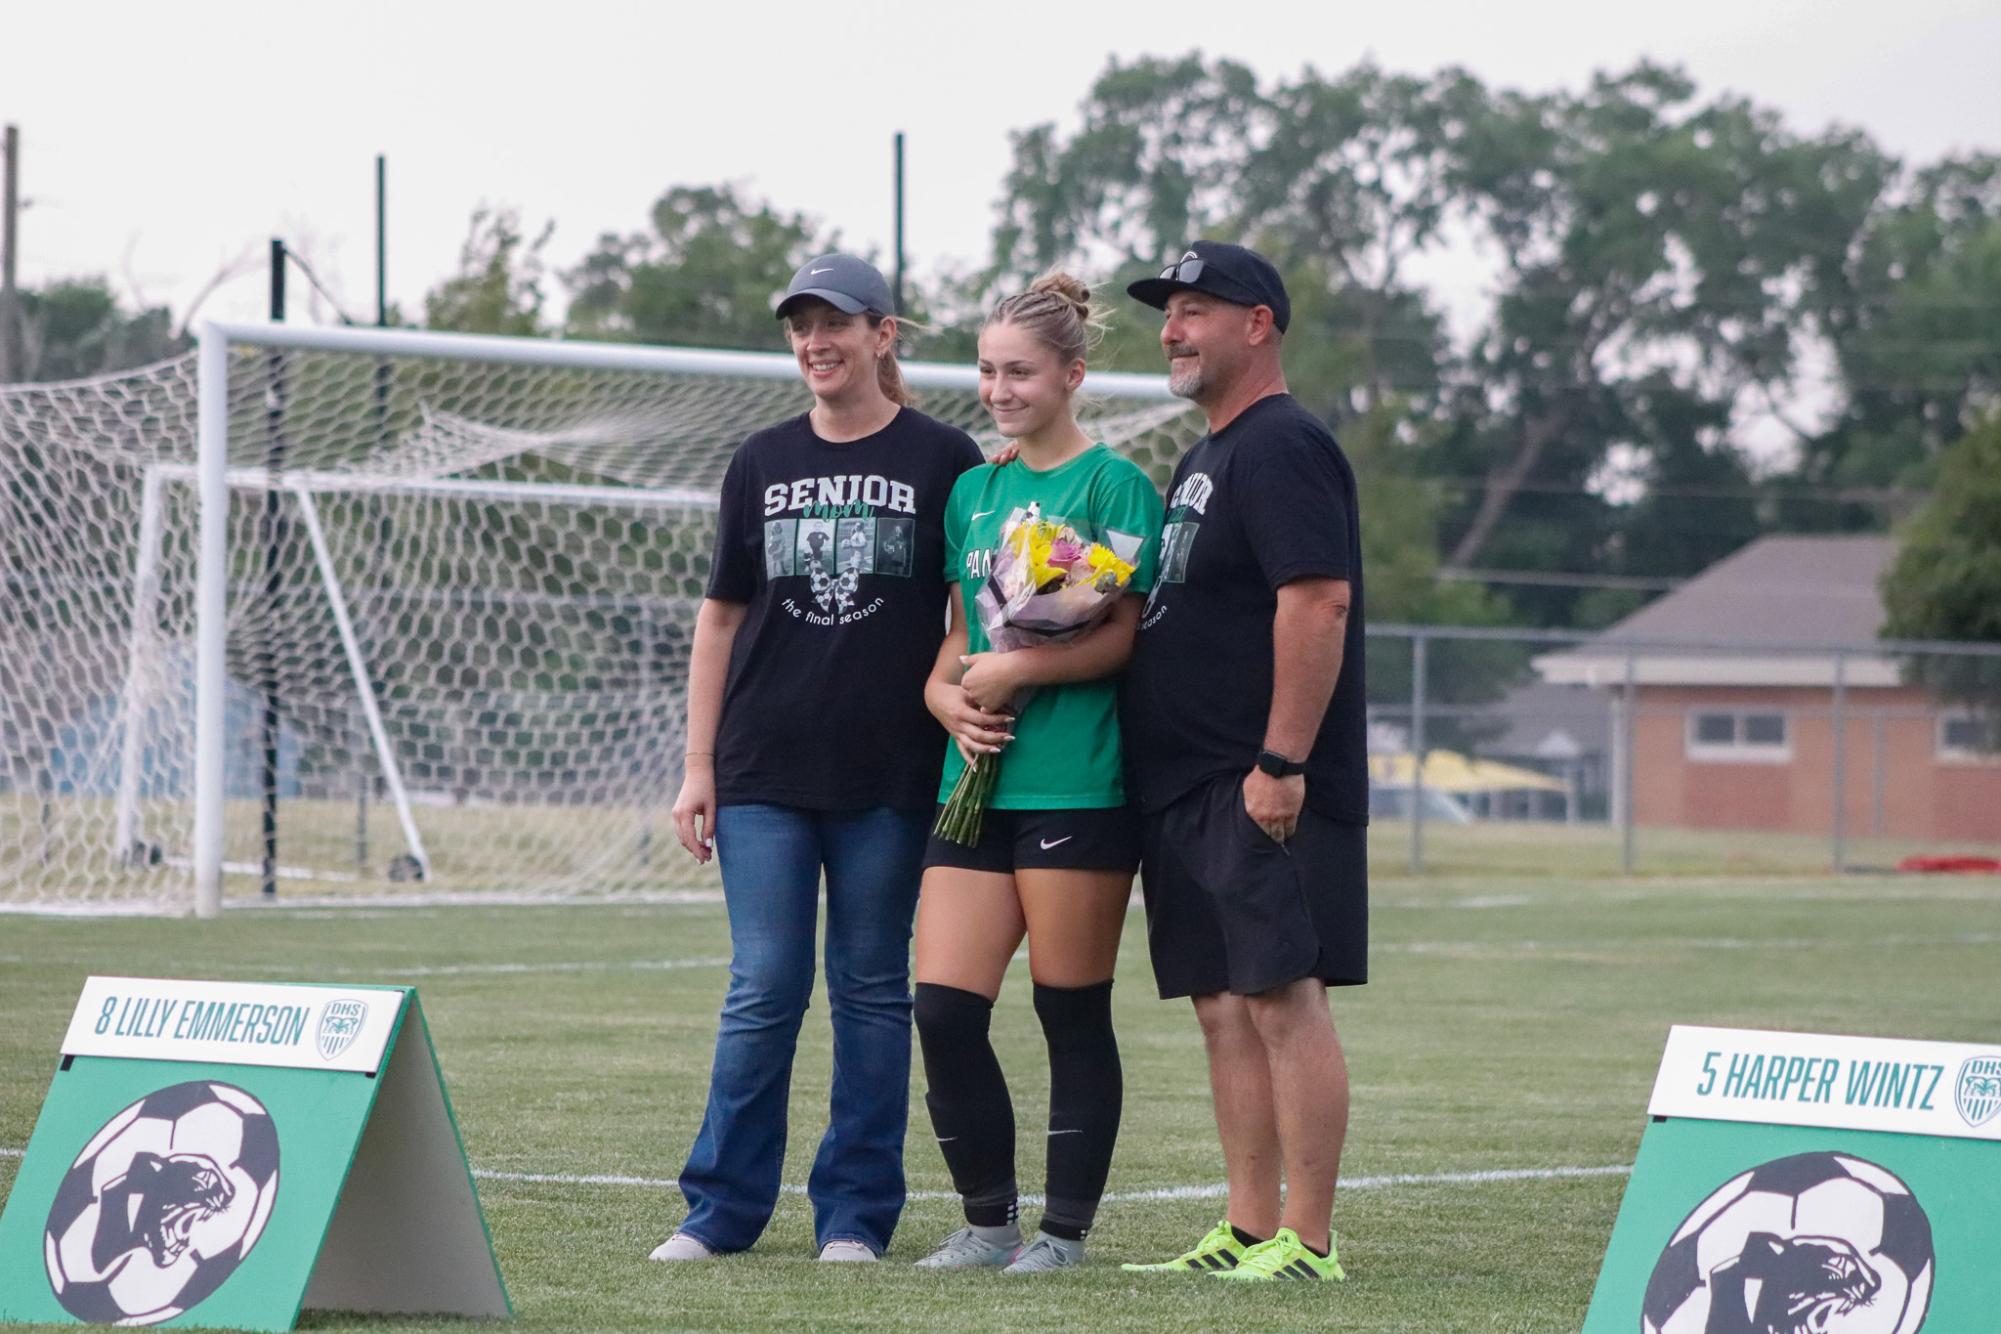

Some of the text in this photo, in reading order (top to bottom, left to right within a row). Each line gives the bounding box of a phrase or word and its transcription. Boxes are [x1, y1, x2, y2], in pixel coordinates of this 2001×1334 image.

[764, 475, 917, 516] SENIOR
[782, 597, 884, 625] the final season
[94, 996, 311, 1046] 8 LILLY EMMERSON
[331, 1002, 361, 1016] DHS
[1696, 1051, 1944, 1111] 5 HARPER WINTZ
